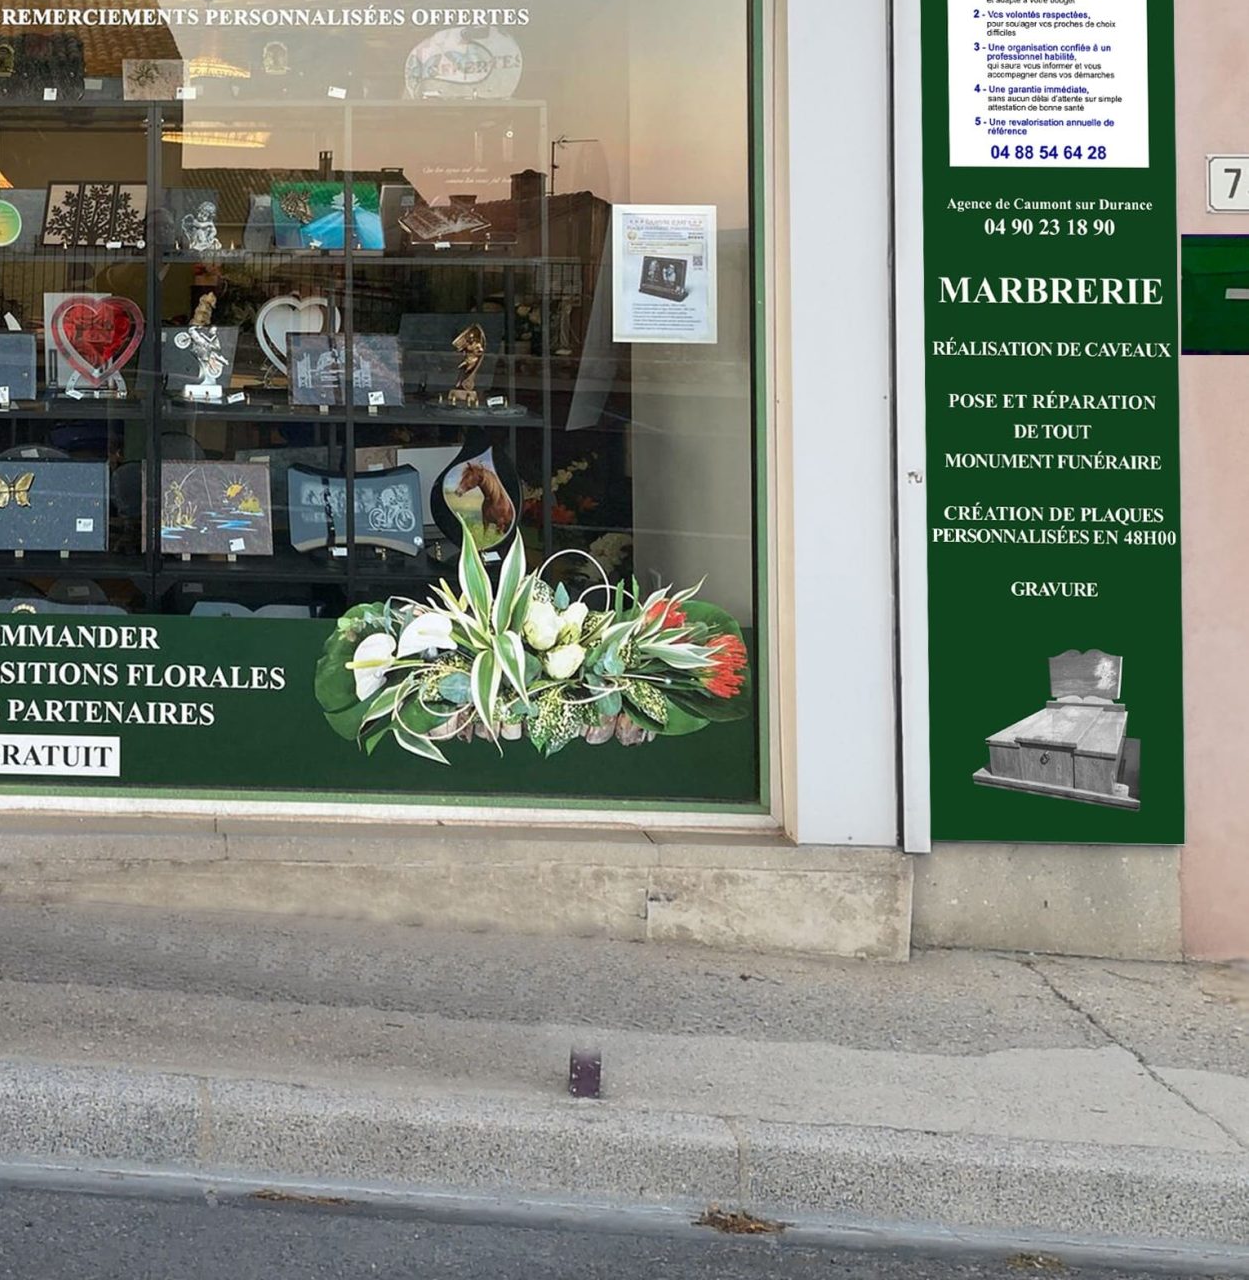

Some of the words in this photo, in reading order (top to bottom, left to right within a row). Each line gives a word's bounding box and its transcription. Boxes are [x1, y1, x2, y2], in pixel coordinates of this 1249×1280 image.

[2, 8, 199, 25] REMERCIEMENTS
[205, 4, 405, 26] PERSONNALISÉES
[411, 8, 530, 24] OFFERTES
[990, 144, 1011, 160] 04
[1014, 144, 1035, 160] 88
[1039, 144, 1059, 160] 54
[1063, 144, 1083, 160] 64
[1087, 145, 1107, 161] 28
[1223, 167, 1249, 199] 7
[947, 198, 992, 213] Agence
[995, 198, 1011, 210] de
[1013, 197, 1072, 210] Caumont
[1075, 201, 1096, 210] sur
[1099, 198, 1153, 211] Durance
[984, 218, 1007, 235] 04
[1011, 218, 1034, 236] 90
[1039, 218, 1061, 236] 23
[1067, 218, 1088, 236] 18
[1093, 218, 1116, 236] 90
[939, 276, 1163, 305] MARBRERIE
[933, 336, 1053, 357] RÉALISATION
[1056, 342, 1082, 357] DE
[1084, 342, 1171, 358] CAVEAUX
[948, 393, 998, 409] POSE
[1003, 393, 1028, 409] ET
[1032, 390, 1156, 410] RÉPARATION
[1014, 424, 1039, 439] DE
[1041, 424, 1092, 440] TOUT
[945, 453, 1054, 469] MONUMENT
[1057, 450, 1162, 470] FUNÉRAIRE
[943, 501, 1044, 522] CRÉATION
[1049, 506, 1075, 522] DE
[1080, 507, 1164, 524] PLAQUES
[932, 528, 1090, 545] PERSONNALISÉES
[1093, 529, 1118, 545] EN
[1123, 530, 1177, 546] 48H00
[1010, 581, 1099, 597] GRAVURE
[127, 664, 286, 690] FLORALES
[7, 699, 215, 726] PARTENAIRES
